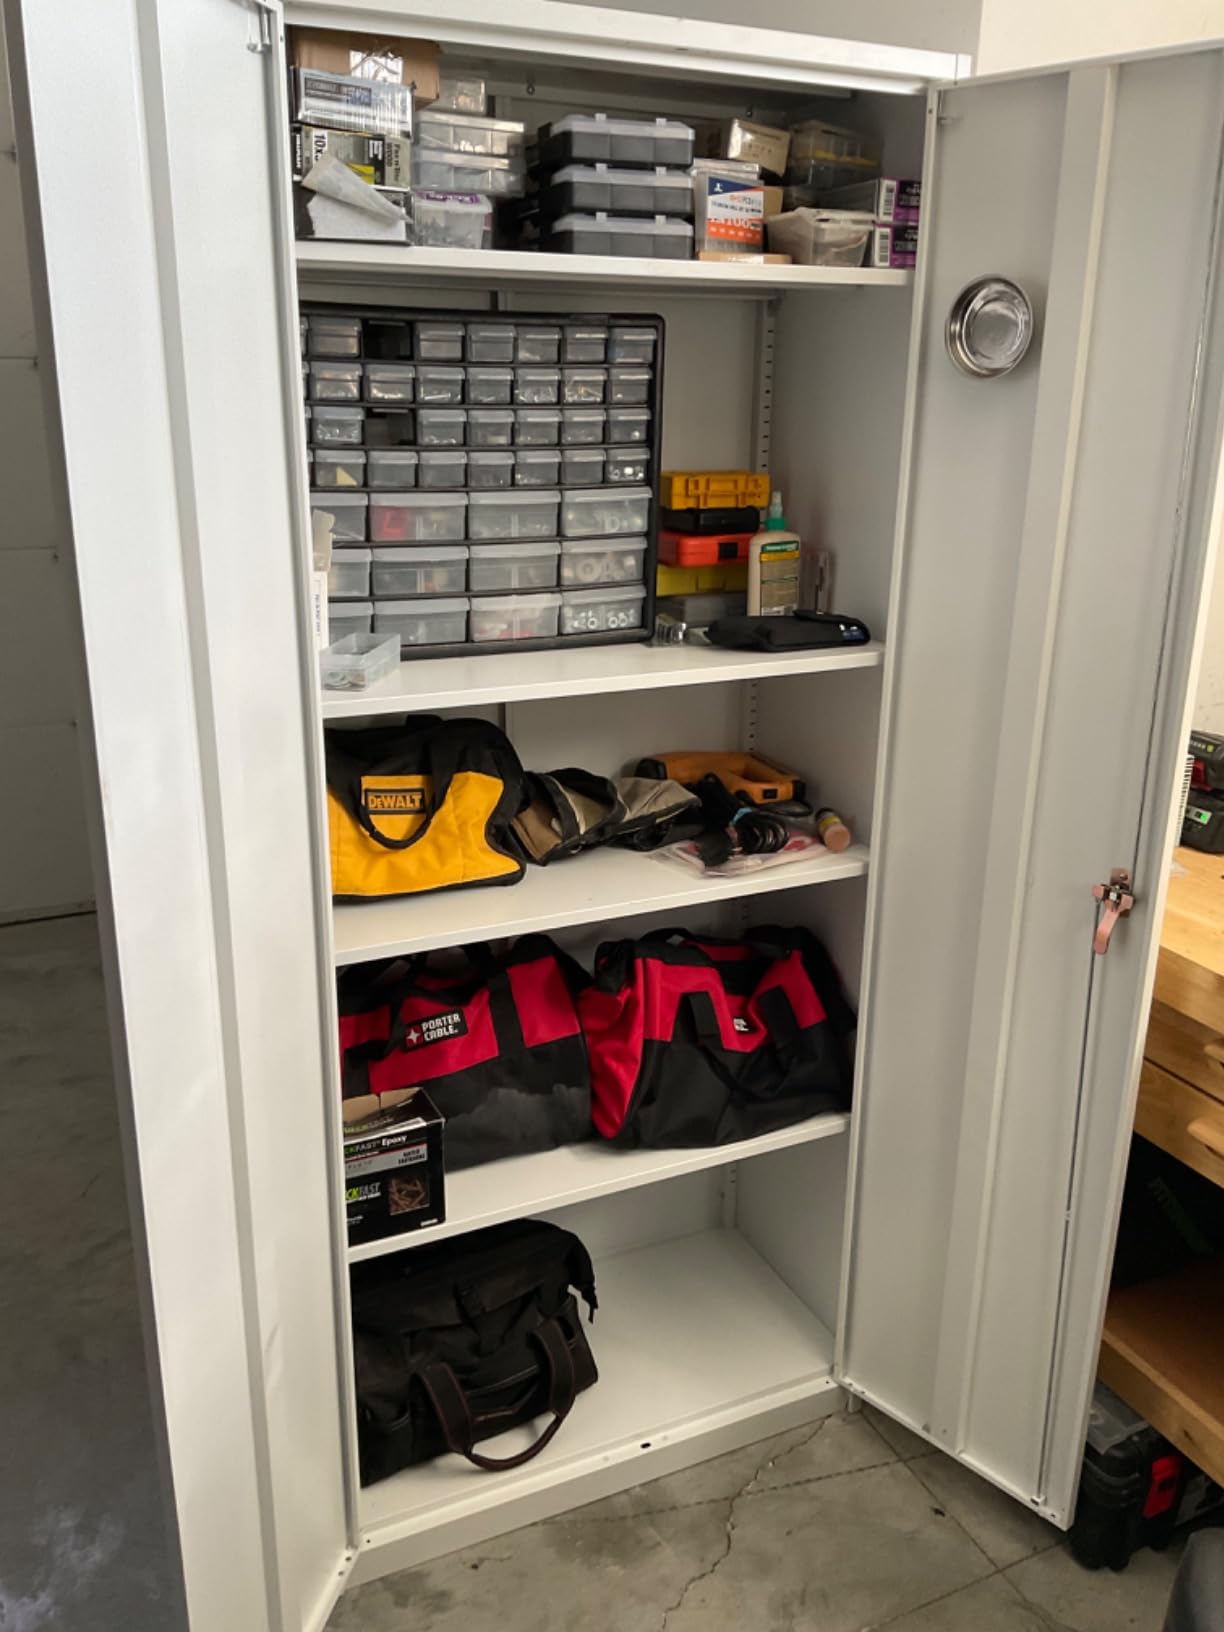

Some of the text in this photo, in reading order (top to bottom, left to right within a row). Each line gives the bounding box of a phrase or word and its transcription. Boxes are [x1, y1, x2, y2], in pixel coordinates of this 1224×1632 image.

[368, 794, 422, 809] DEWALT
[421, 1013, 461, 1032] PORTER
[381, 1135, 408, 1147] Epoxy
